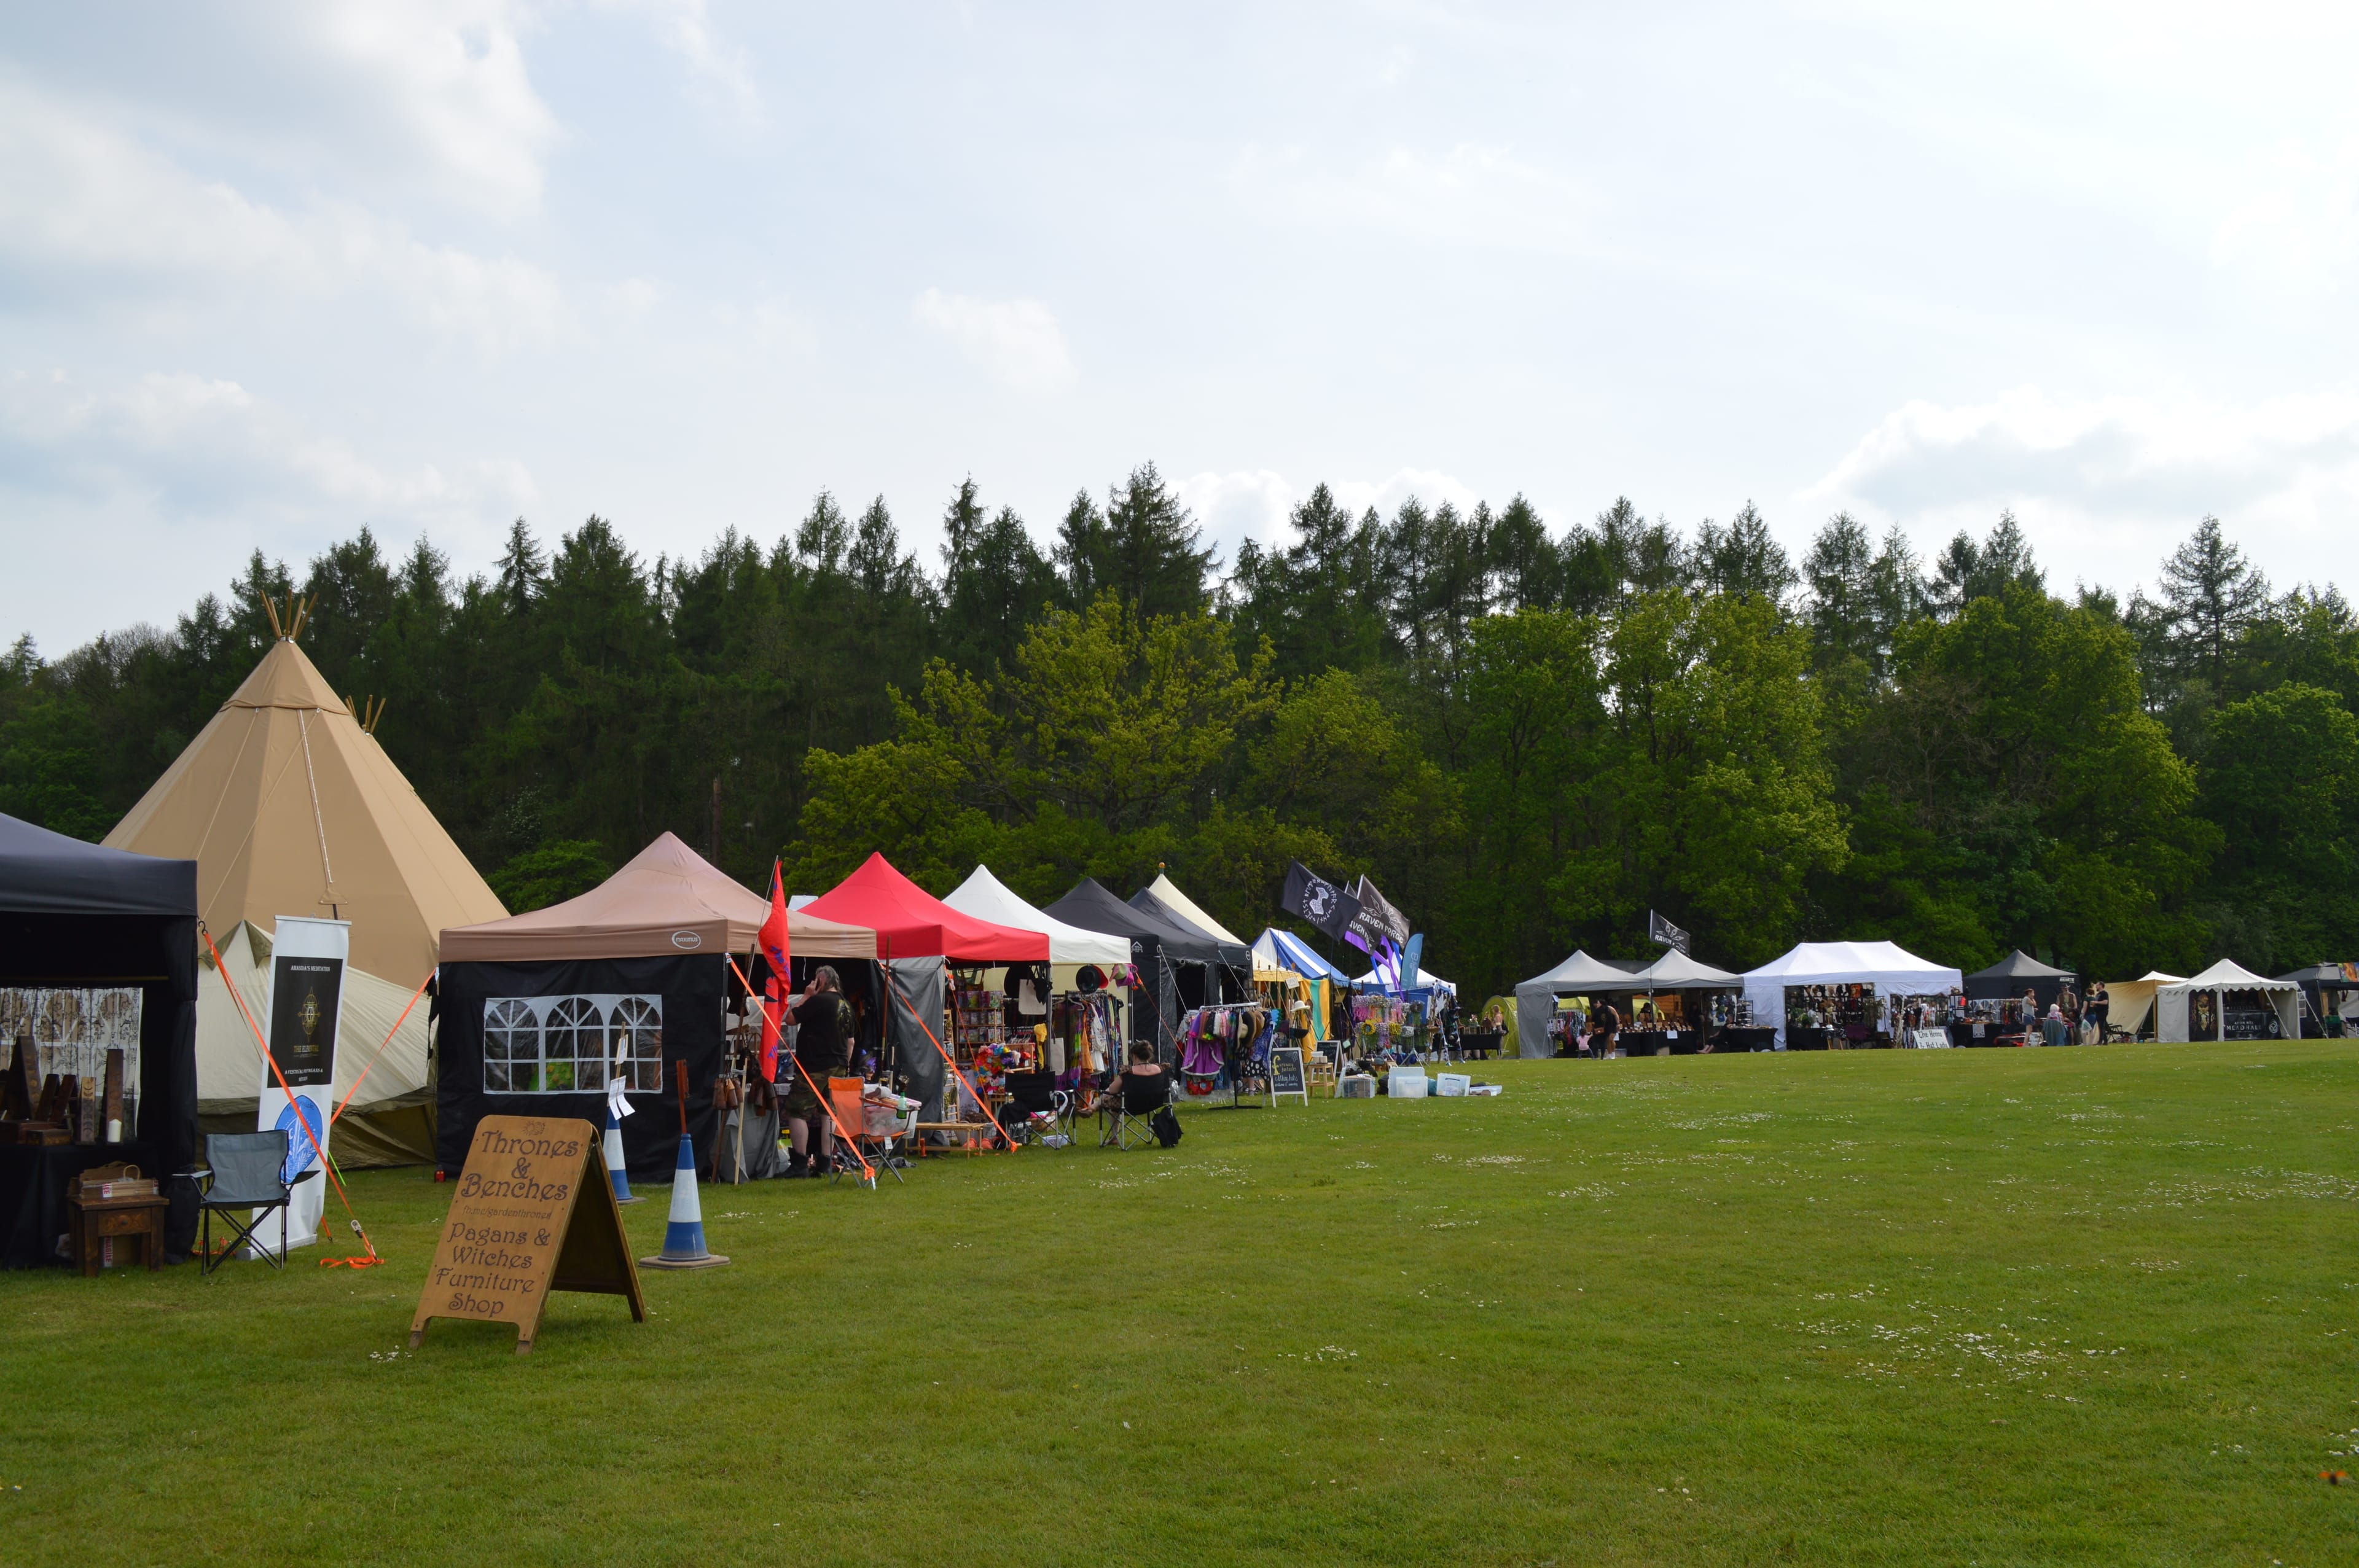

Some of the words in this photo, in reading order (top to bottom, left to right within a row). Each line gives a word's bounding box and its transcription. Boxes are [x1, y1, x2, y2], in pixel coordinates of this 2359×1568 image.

[1359, 911, 1384, 930] RAVEN
[1384, 925, 1404, 944] FORGE
[481, 1130, 579, 1158] Thrones
[511, 1156, 531, 1180] &
[461, 1172, 568, 1201] Benches
[447, 1222, 528, 1246] Pagans
[533, 1228, 551, 1246] &
[453, 1246, 533, 1269] Witches
[436, 1268, 535, 1293] Furniture
[448, 1292, 504, 1318] Shop
